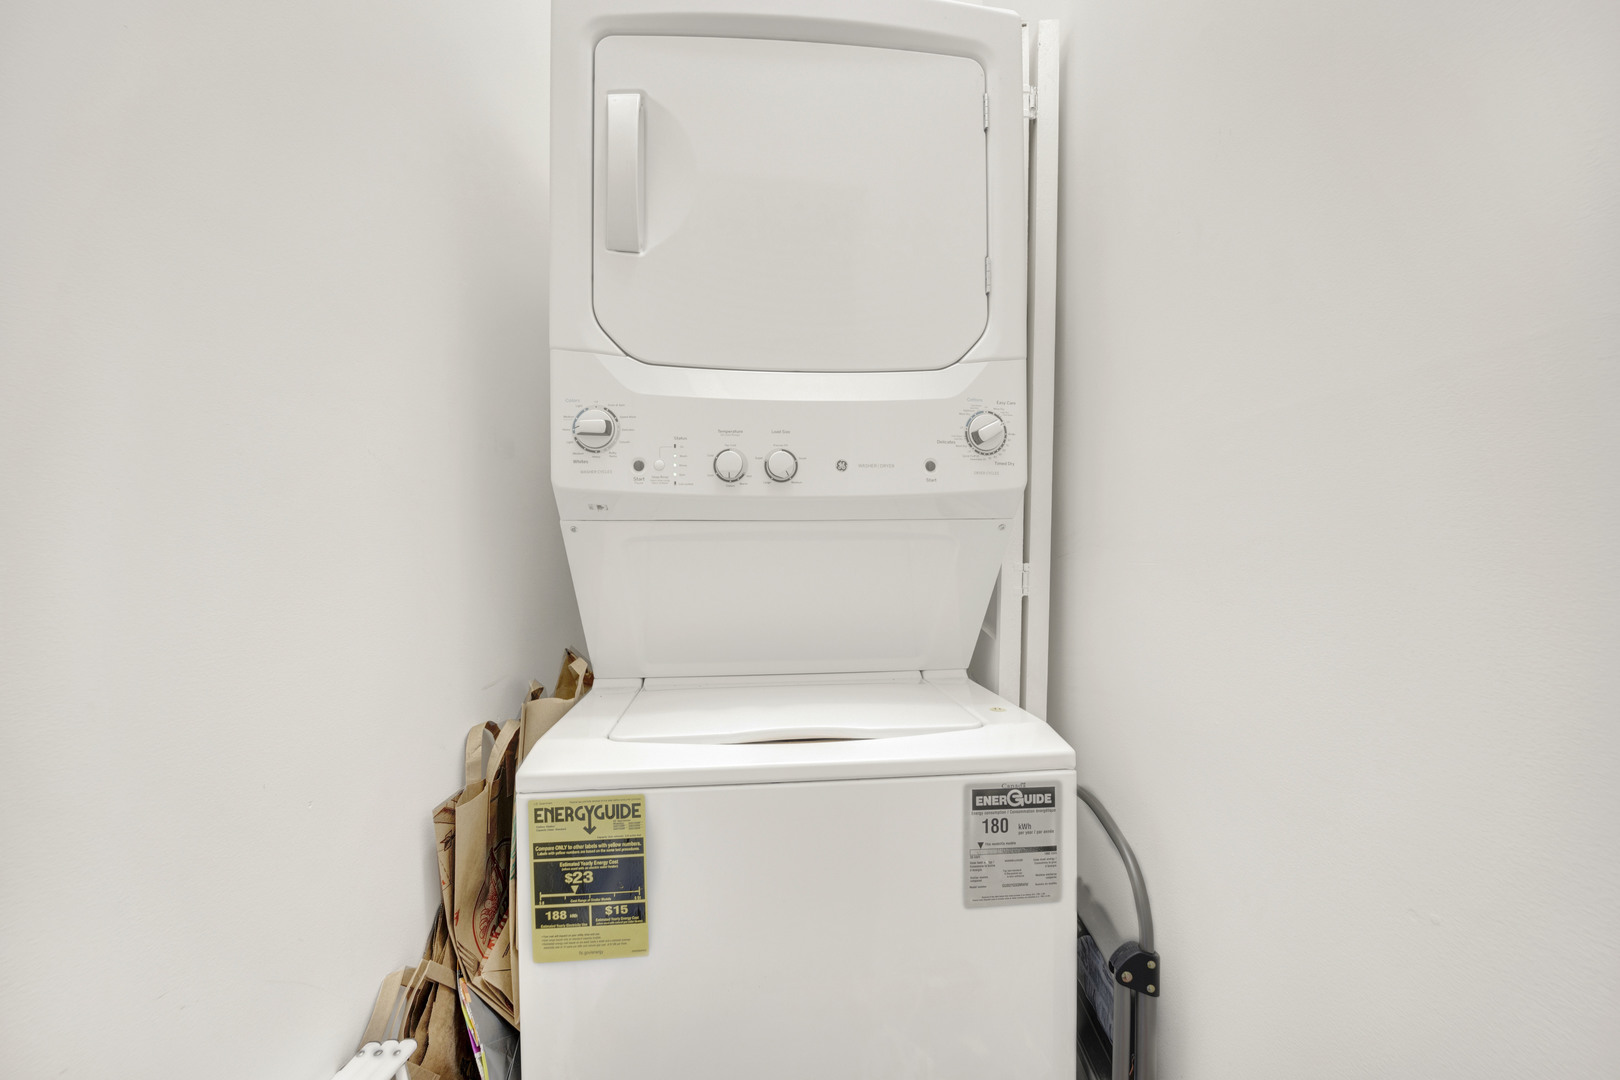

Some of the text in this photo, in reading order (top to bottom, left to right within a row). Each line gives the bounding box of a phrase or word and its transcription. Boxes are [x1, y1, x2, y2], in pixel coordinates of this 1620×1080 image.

[975, 789, 1053, 807] ENERGUIDE
[534, 802, 642, 824] ENERGYGUIDE
[982, 818, 1009, 834] 180
[564, 871, 594, 884] $23
[545, 910, 567, 921] 188
[605, 905, 629, 917] $15
